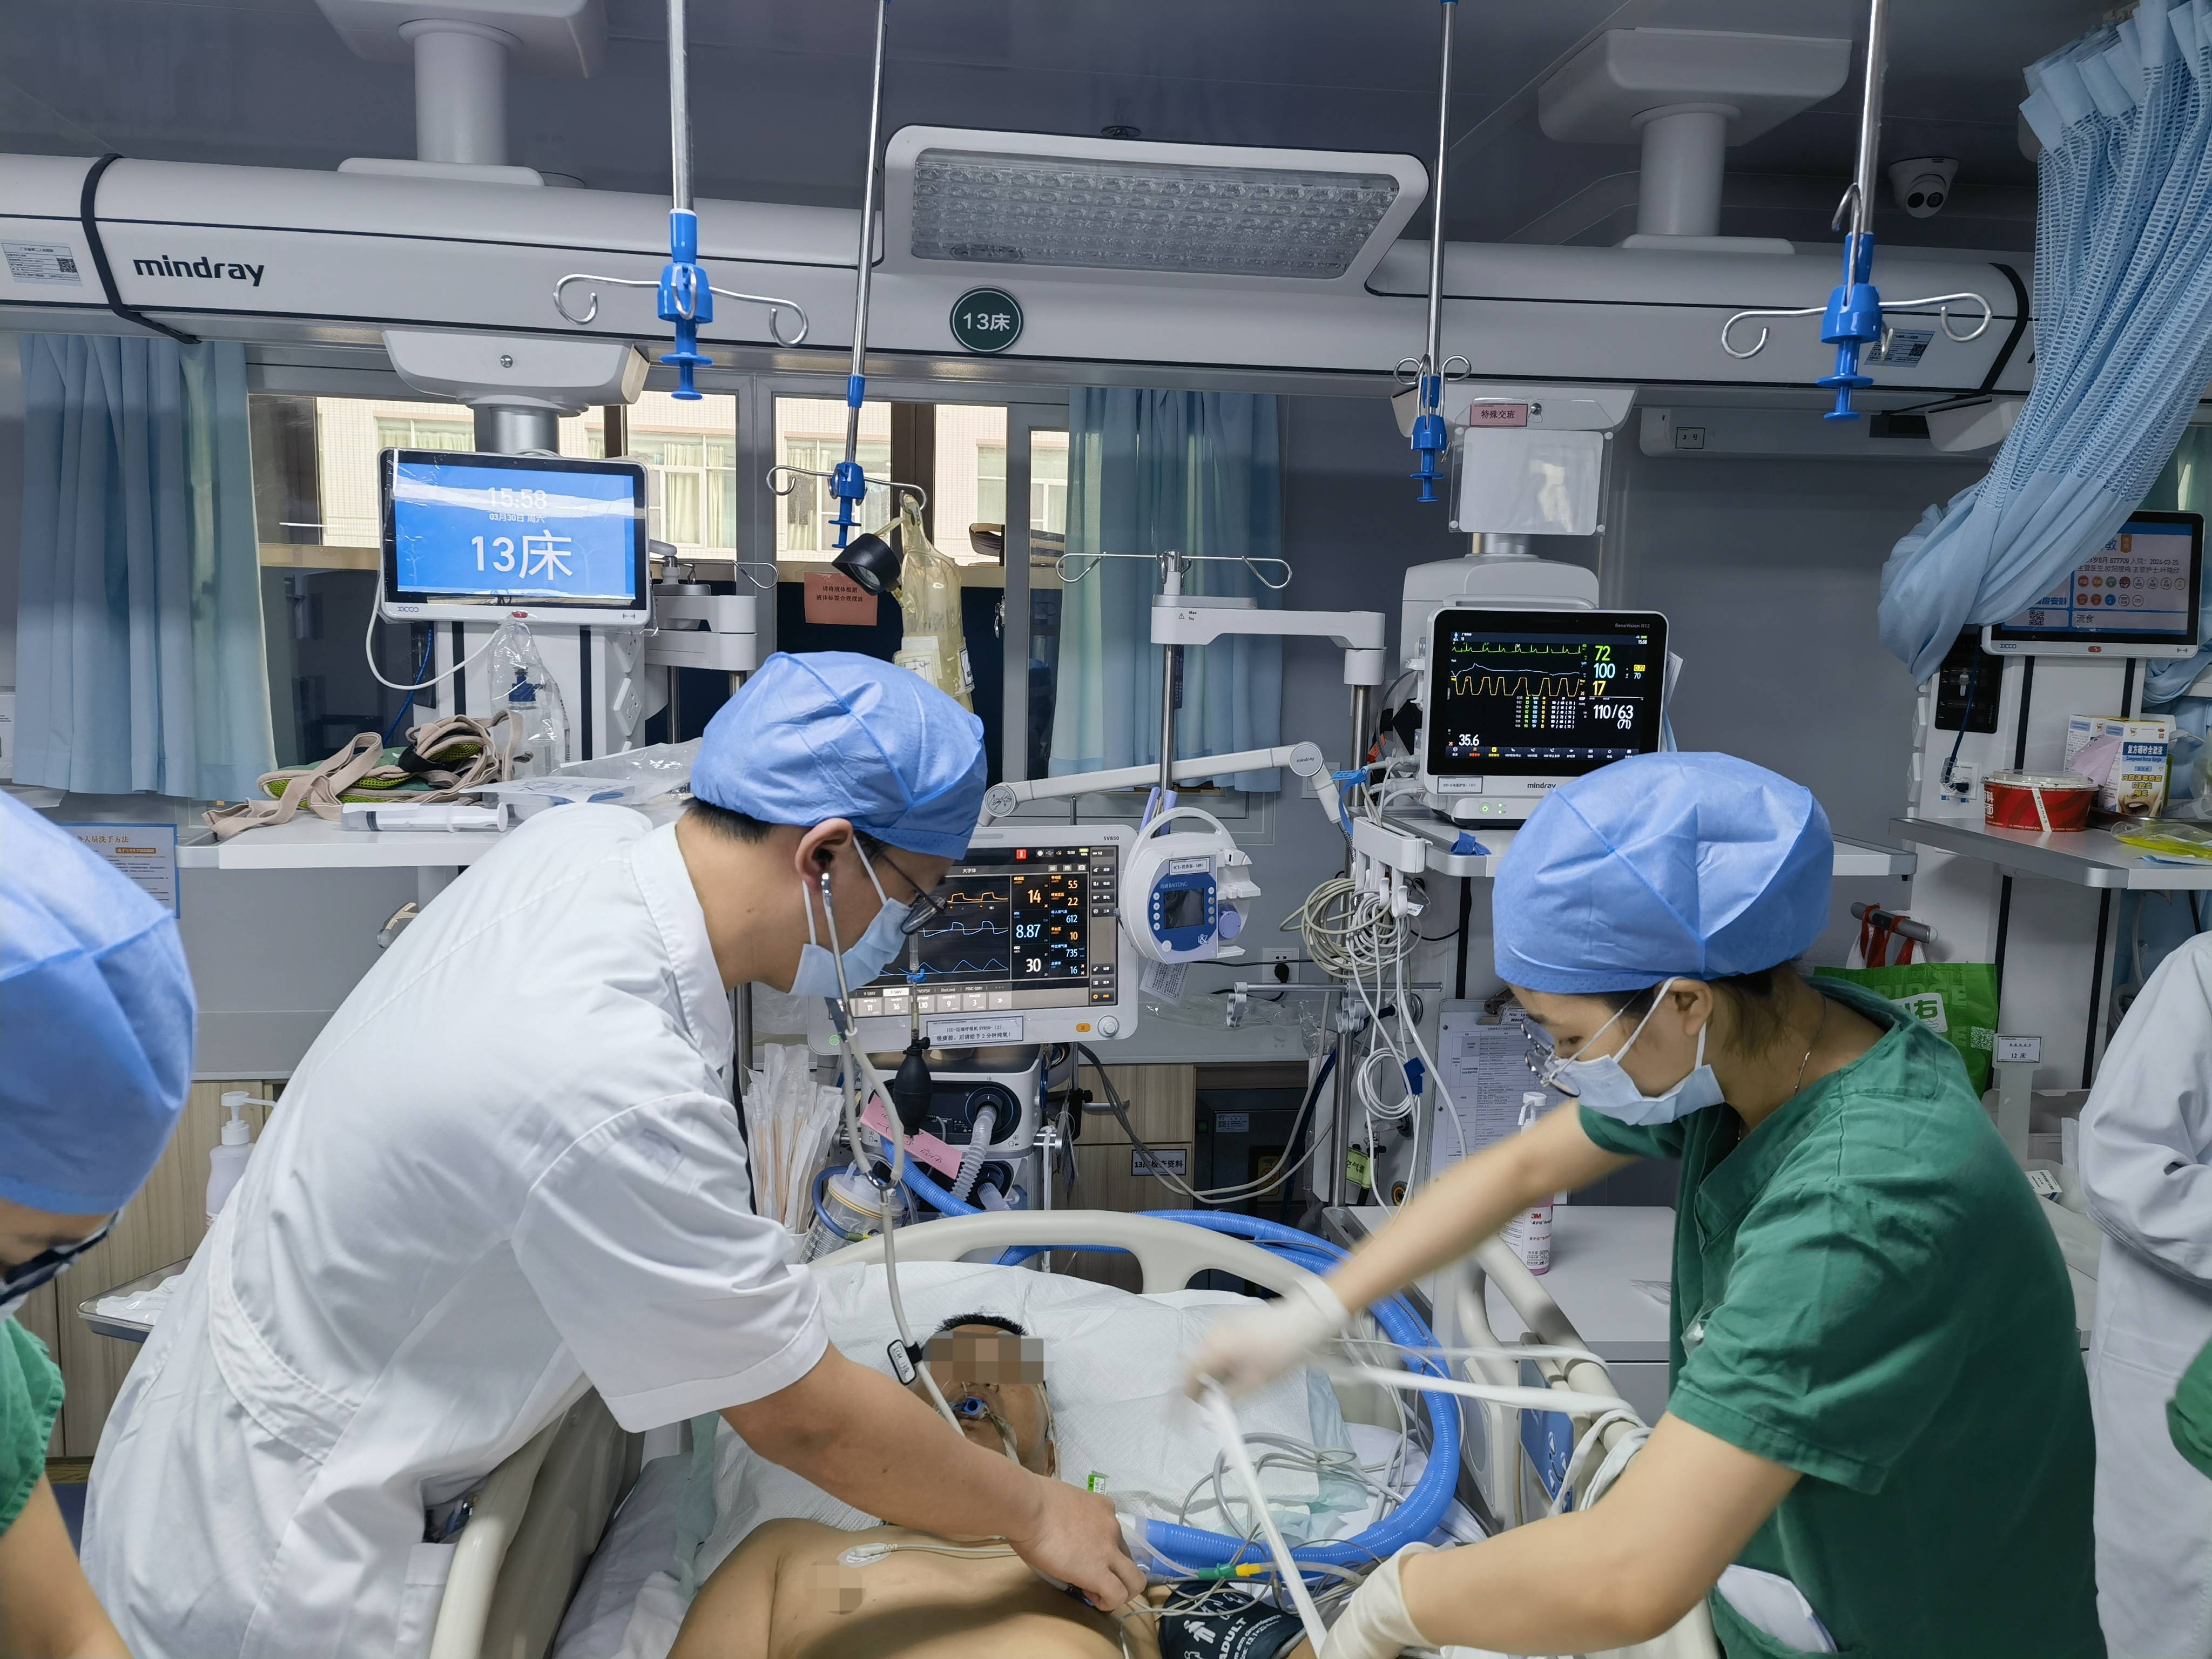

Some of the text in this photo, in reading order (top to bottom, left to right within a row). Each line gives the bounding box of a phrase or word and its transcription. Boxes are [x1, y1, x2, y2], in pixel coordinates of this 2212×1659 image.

[133, 255, 264, 287] mindray
[963, 312, 1010, 332] 13床
[1481, 410, 1515, 419] 特殊交班
[488, 487, 548, 509] 15:58
[489, 512, 545, 523] 03月30日 周六
[471, 530, 573, 581] 13床
[1595, 645, 1610, 661] 72
[1594, 663, 1615, 678] 100
[1593, 680, 1606, 696] 17
[1594, 704, 1633, 719] 110/63
[1617, 719, 1631, 729] (71)
[1459, 734, 1480, 746] 35.6
[1028, 889, 1041, 903] 14
[1066, 914, 1077, 923] 612
[1016, 924, 1041, 938] 8.87
[1070, 932, 1078, 940] 10
[1066, 949, 1078, 957] 735
[1026, 958, 1041, 973] 30
[1070, 966, 1077, 974] 16
[1135, 1159, 1183, 1168] 13检查资料
